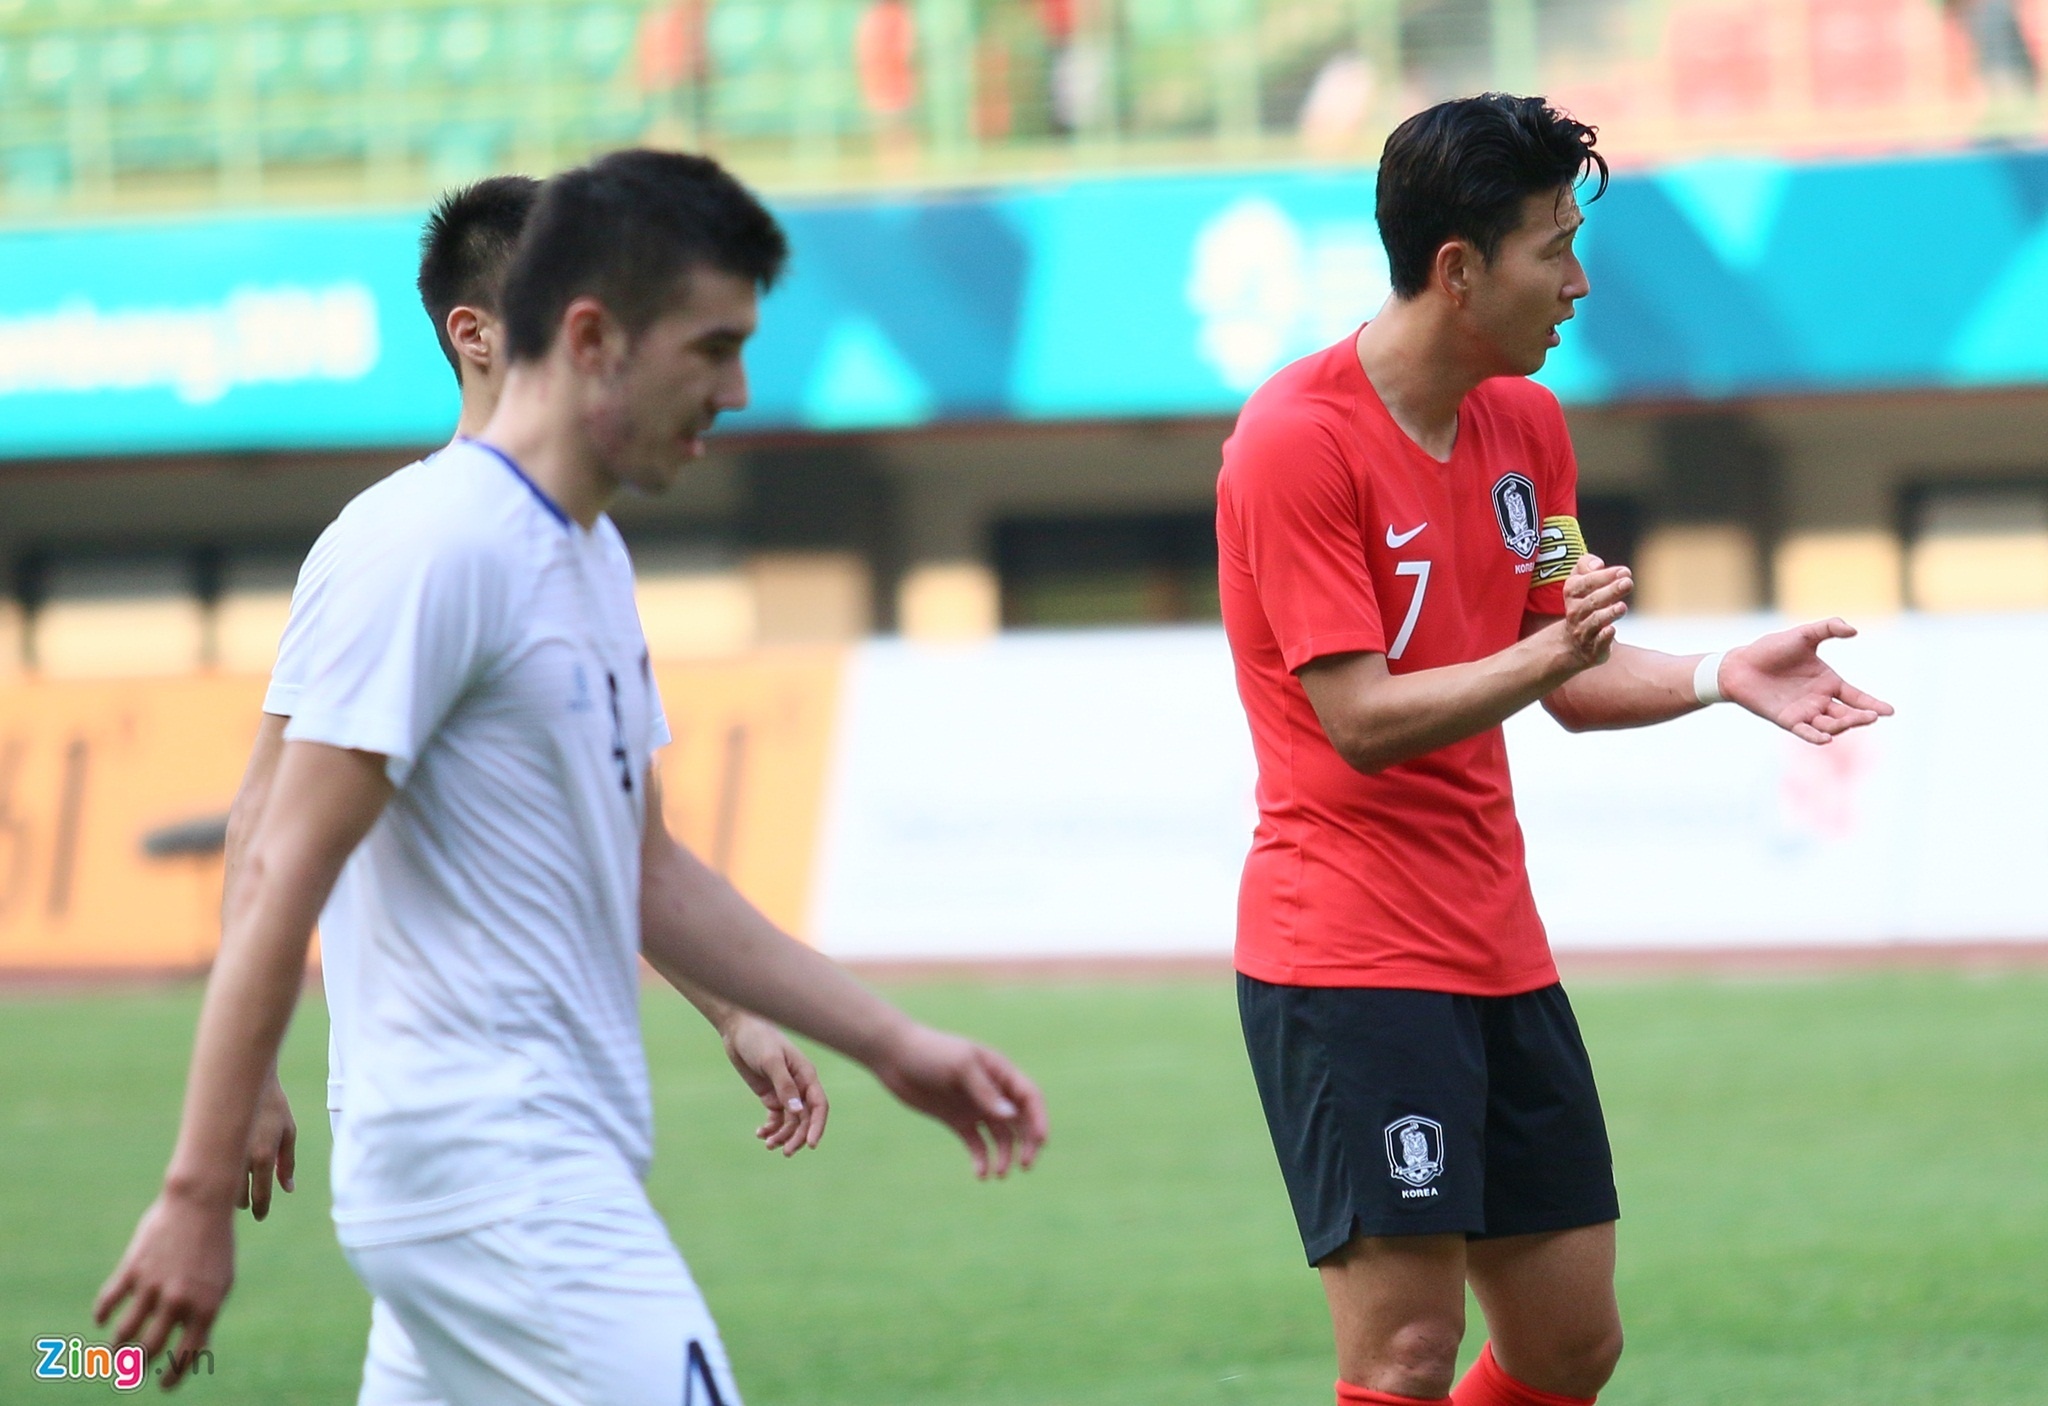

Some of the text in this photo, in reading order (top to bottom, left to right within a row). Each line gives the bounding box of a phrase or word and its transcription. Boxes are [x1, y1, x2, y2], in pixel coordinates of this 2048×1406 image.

[1514, 562, 1536, 574] KORE
[1388, 560, 1432, 660] 7
[1401, 1187, 1439, 1199] KOREA
